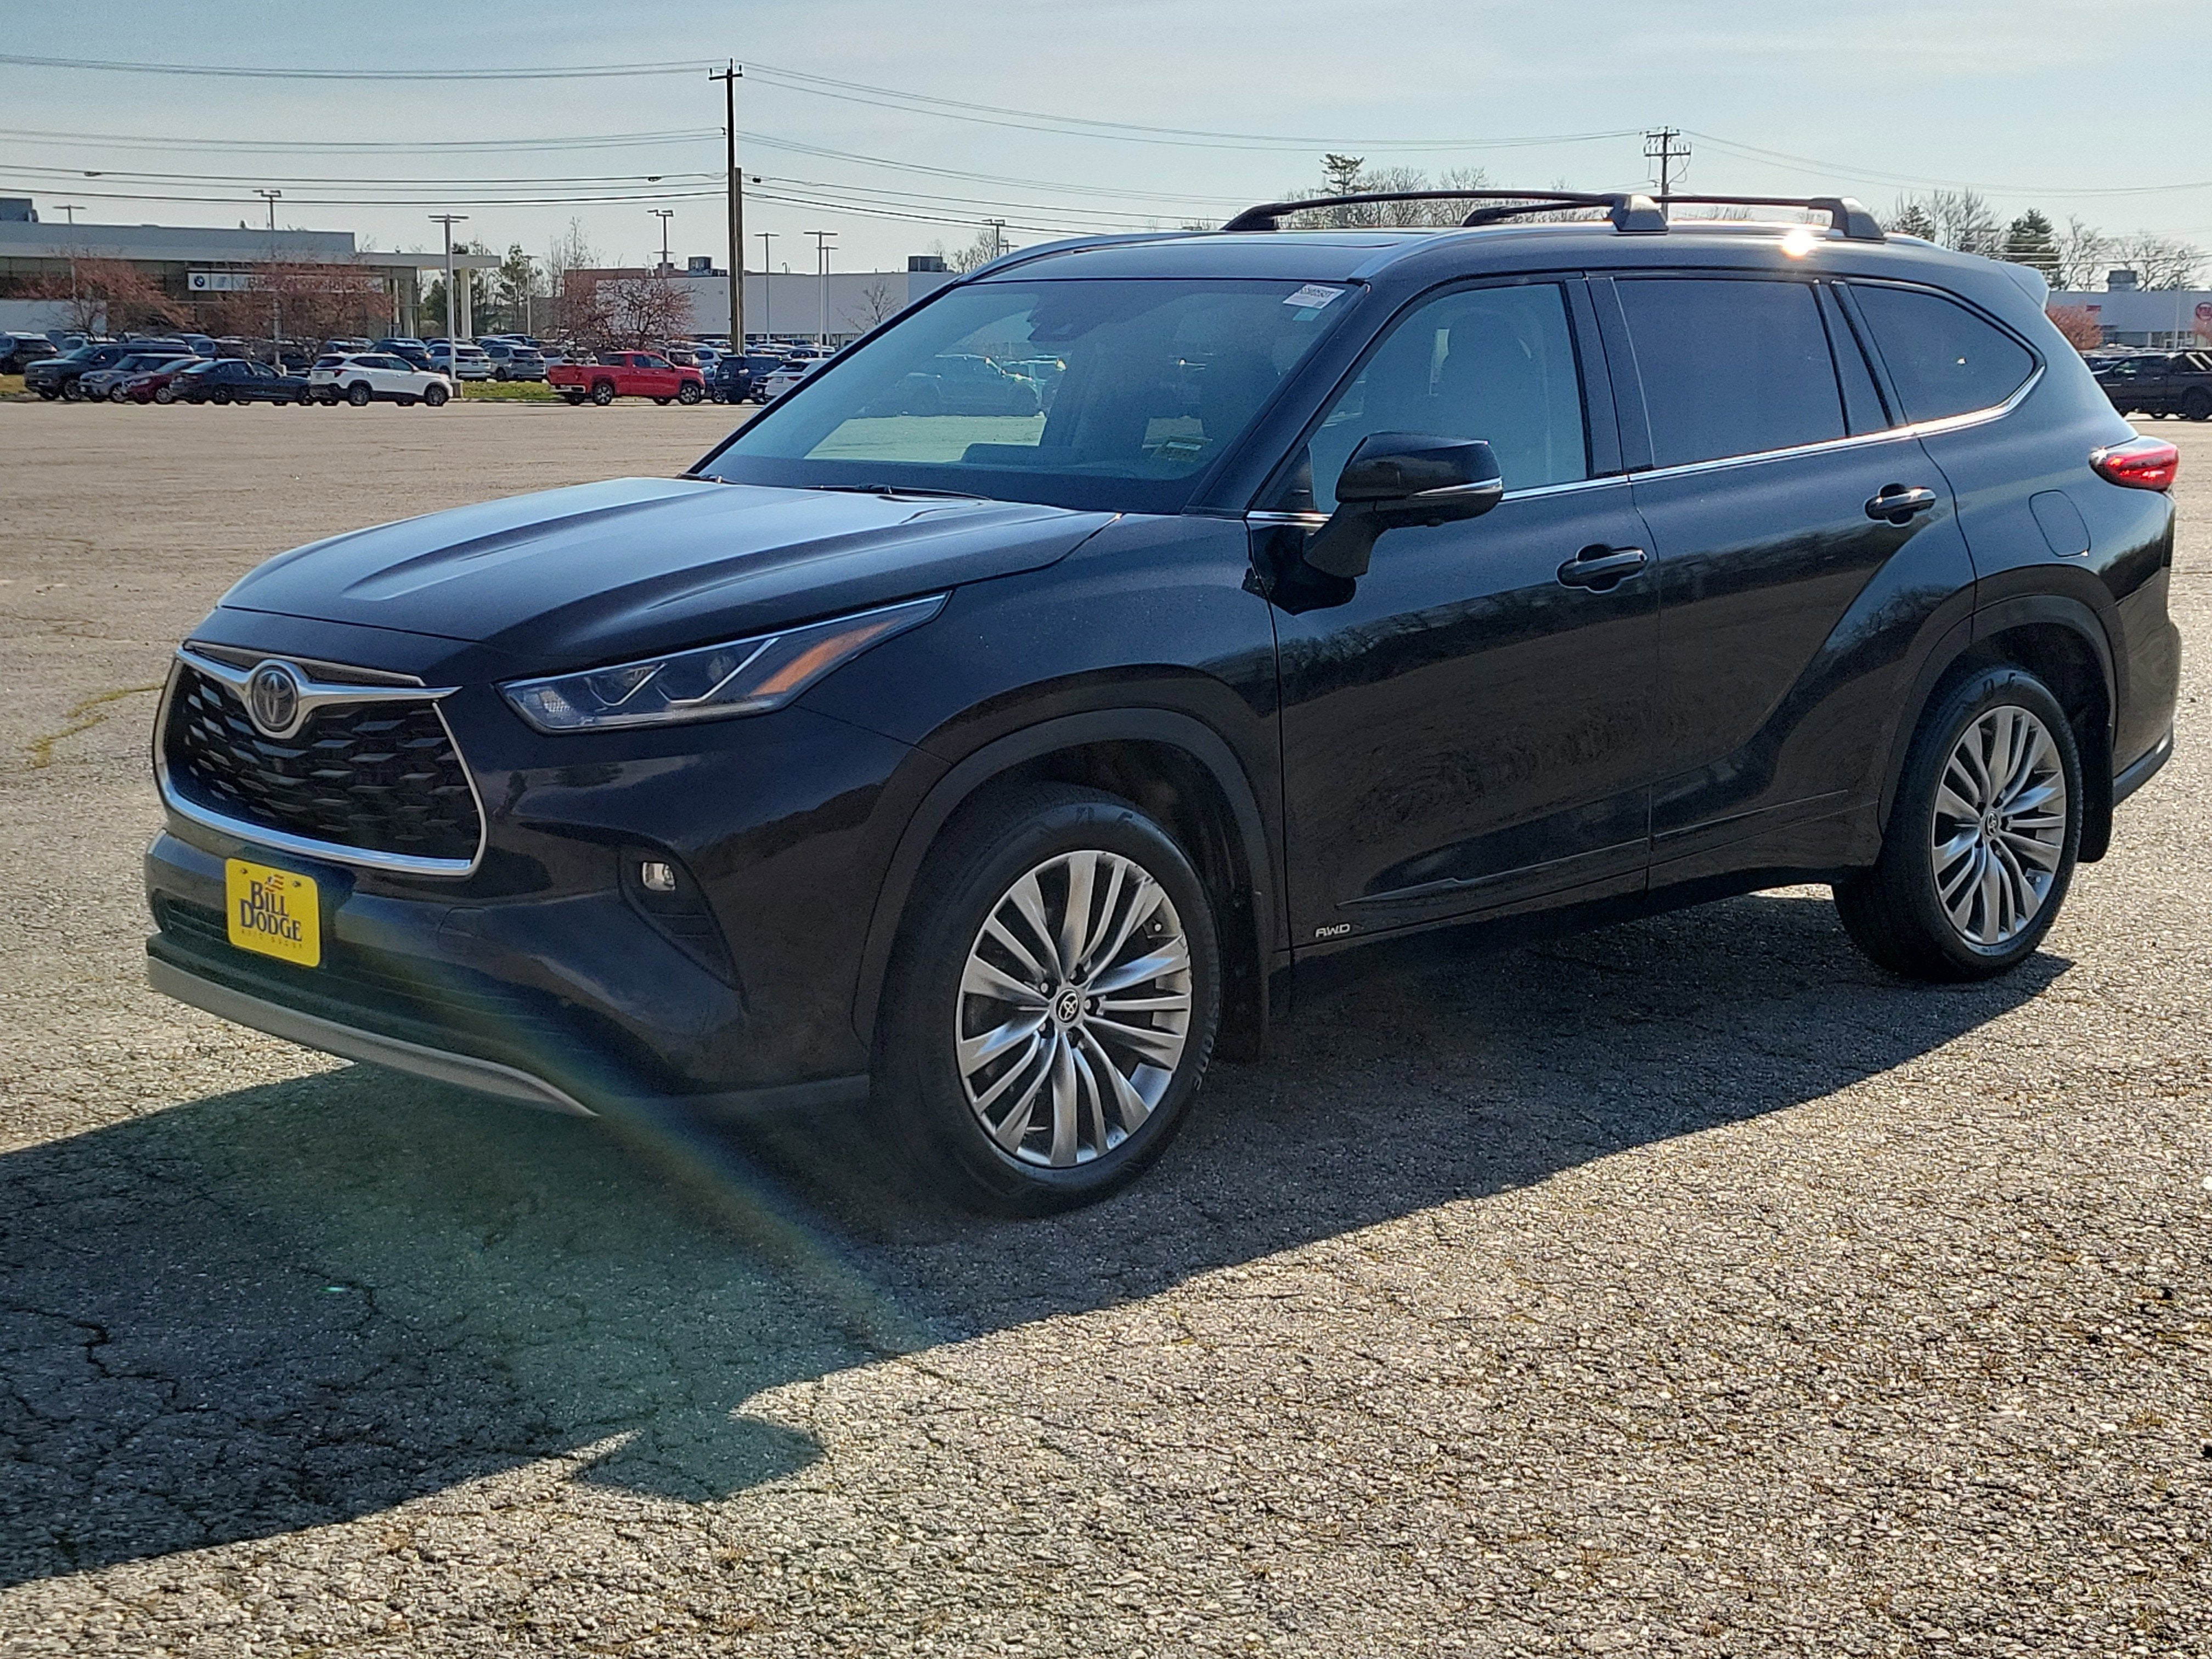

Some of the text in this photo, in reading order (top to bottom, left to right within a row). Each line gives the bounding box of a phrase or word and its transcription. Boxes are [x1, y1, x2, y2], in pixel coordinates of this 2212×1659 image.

[251, 881, 289, 917] BILL
[240, 899, 302, 941] DODGE
[1315, 923, 1351, 938] AWD
